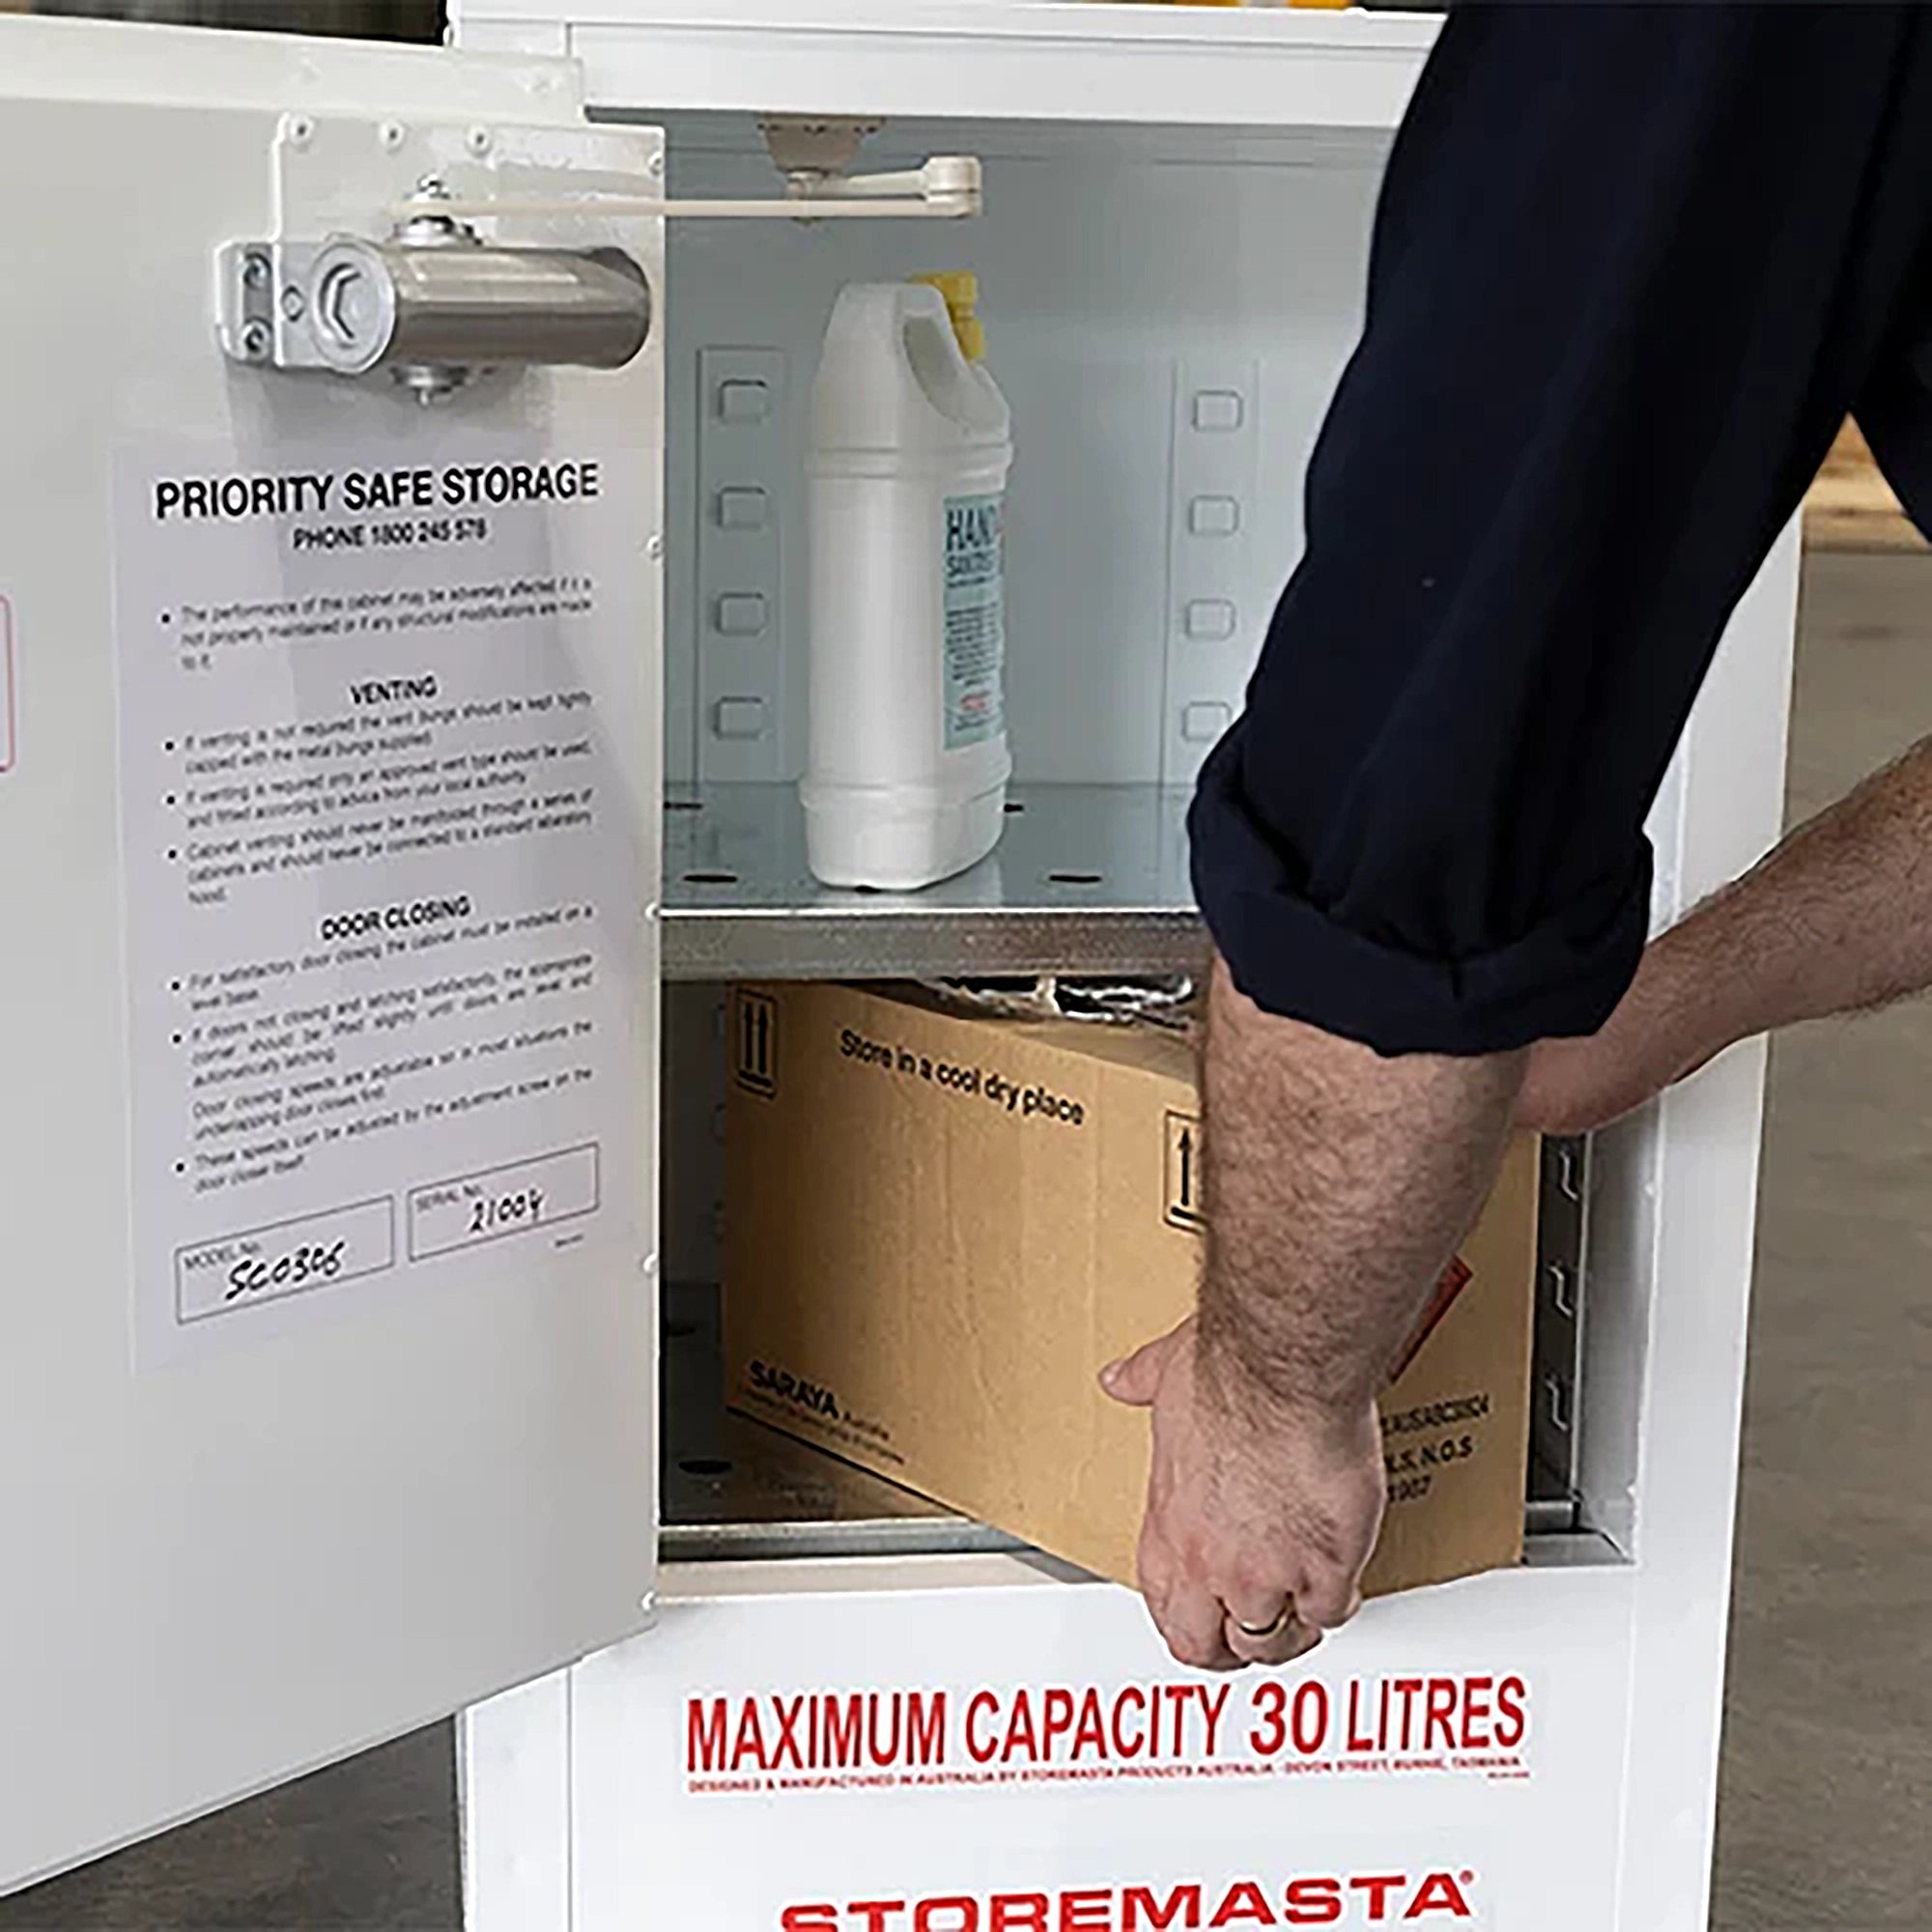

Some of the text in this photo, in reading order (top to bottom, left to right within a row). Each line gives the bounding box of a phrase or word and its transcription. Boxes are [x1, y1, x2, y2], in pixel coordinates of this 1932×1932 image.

[156, 463, 599, 519] PRIORITY SAFE STORAGE
[294, 524, 364, 549] PHONE
[350, 675, 437, 705] VENTING
[322, 895, 471, 939] DOOR CLOSING
[839, 1029, 1085, 1126] Store in a cool dry place
[748, 1359, 840, 1420] SARAYA
[687, 1676, 1526, 1772] MAXIMUM CAPACITY 30 LITRES
